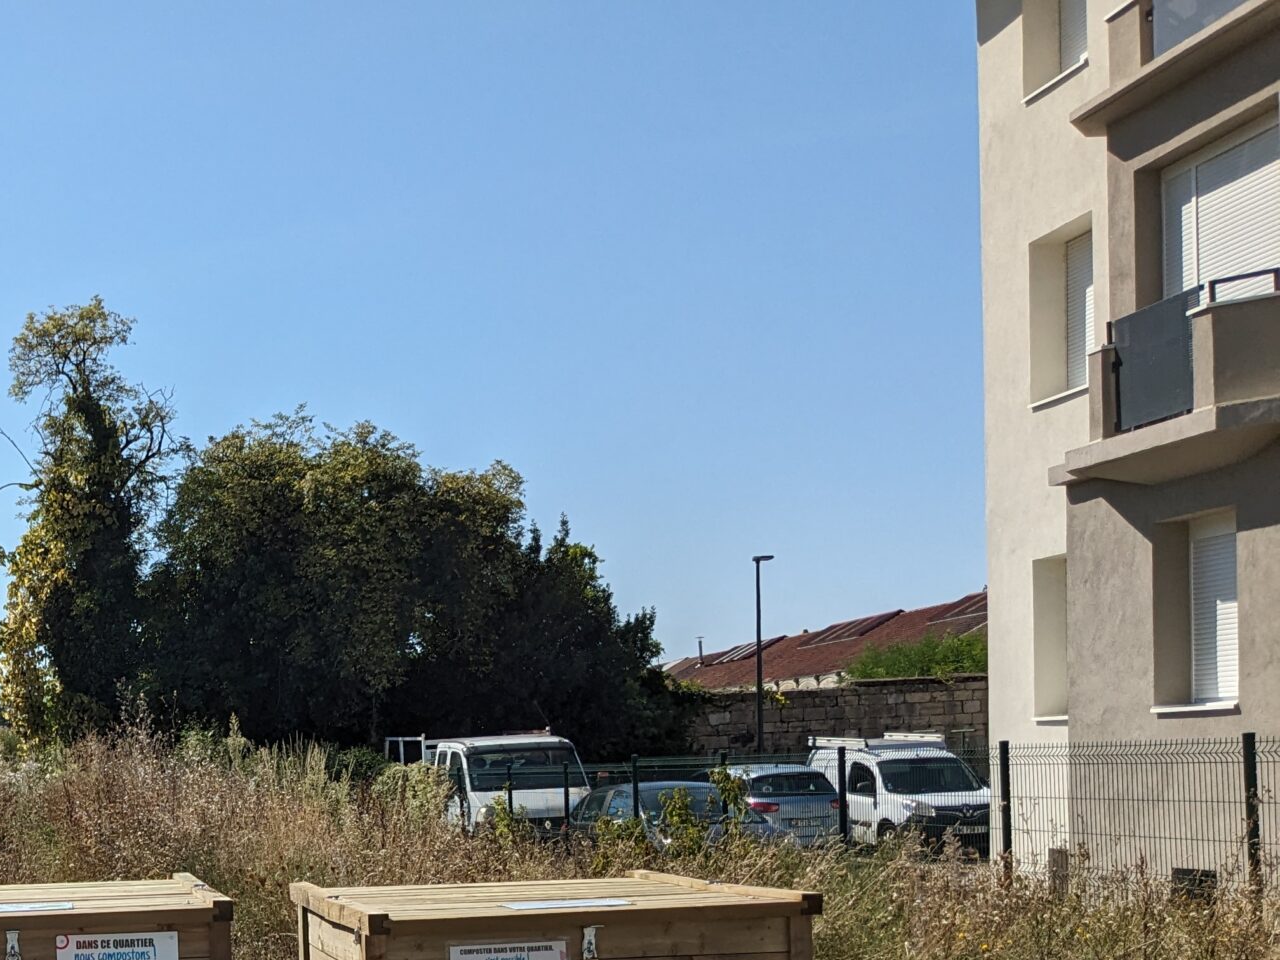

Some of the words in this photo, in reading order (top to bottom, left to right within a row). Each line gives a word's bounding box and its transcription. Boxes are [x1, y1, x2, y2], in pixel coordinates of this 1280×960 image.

[76, 939, 99, 950] DANS
[101, 939, 111, 949] CE
[460, 947, 492, 956] COMPOSTER
